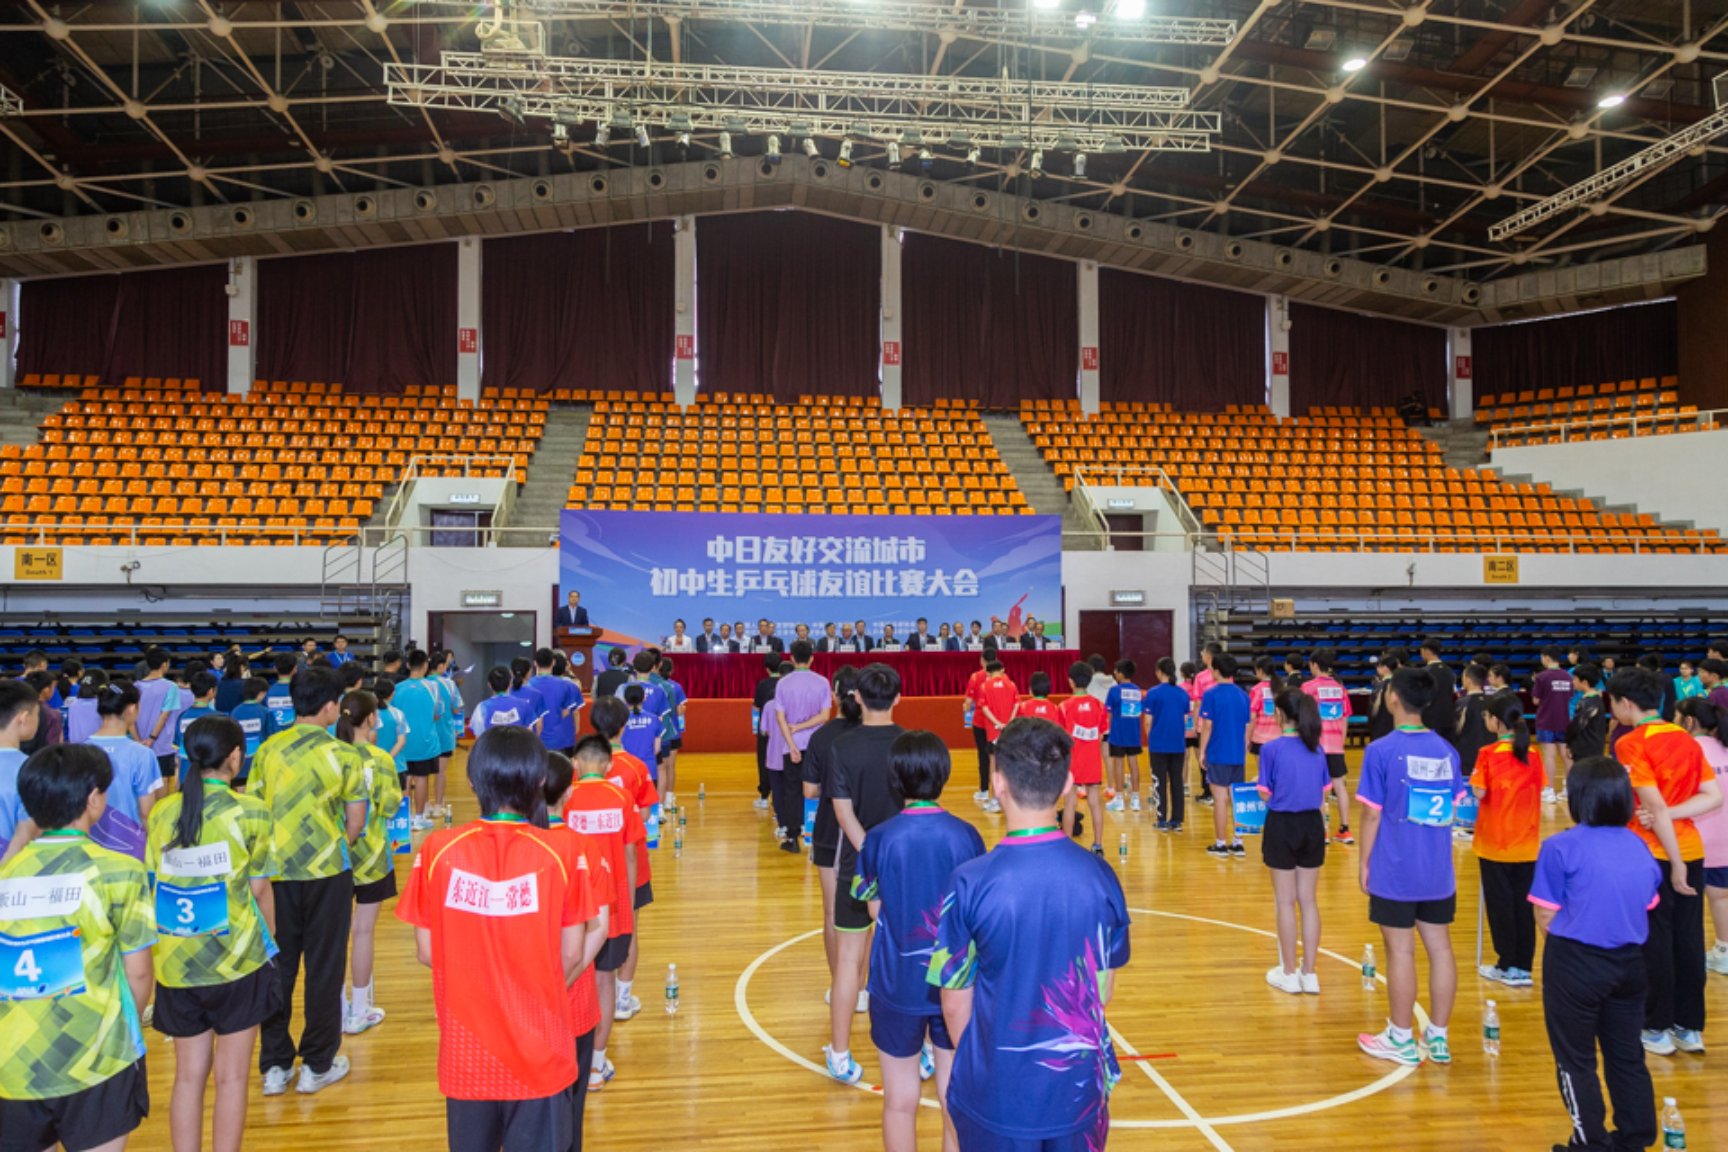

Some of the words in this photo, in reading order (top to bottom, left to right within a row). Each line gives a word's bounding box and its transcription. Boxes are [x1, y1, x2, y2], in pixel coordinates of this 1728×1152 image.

[21, 552, 57, 567] 南一区
[707, 535, 926, 564] 中日友好交流城市
[650, 567, 979, 597] 初中生乒乓球友谊比赛大会
[1429, 795, 1445, 816] 2
[175, 897, 196, 924] 3
[14, 949, 42, 982] 4
